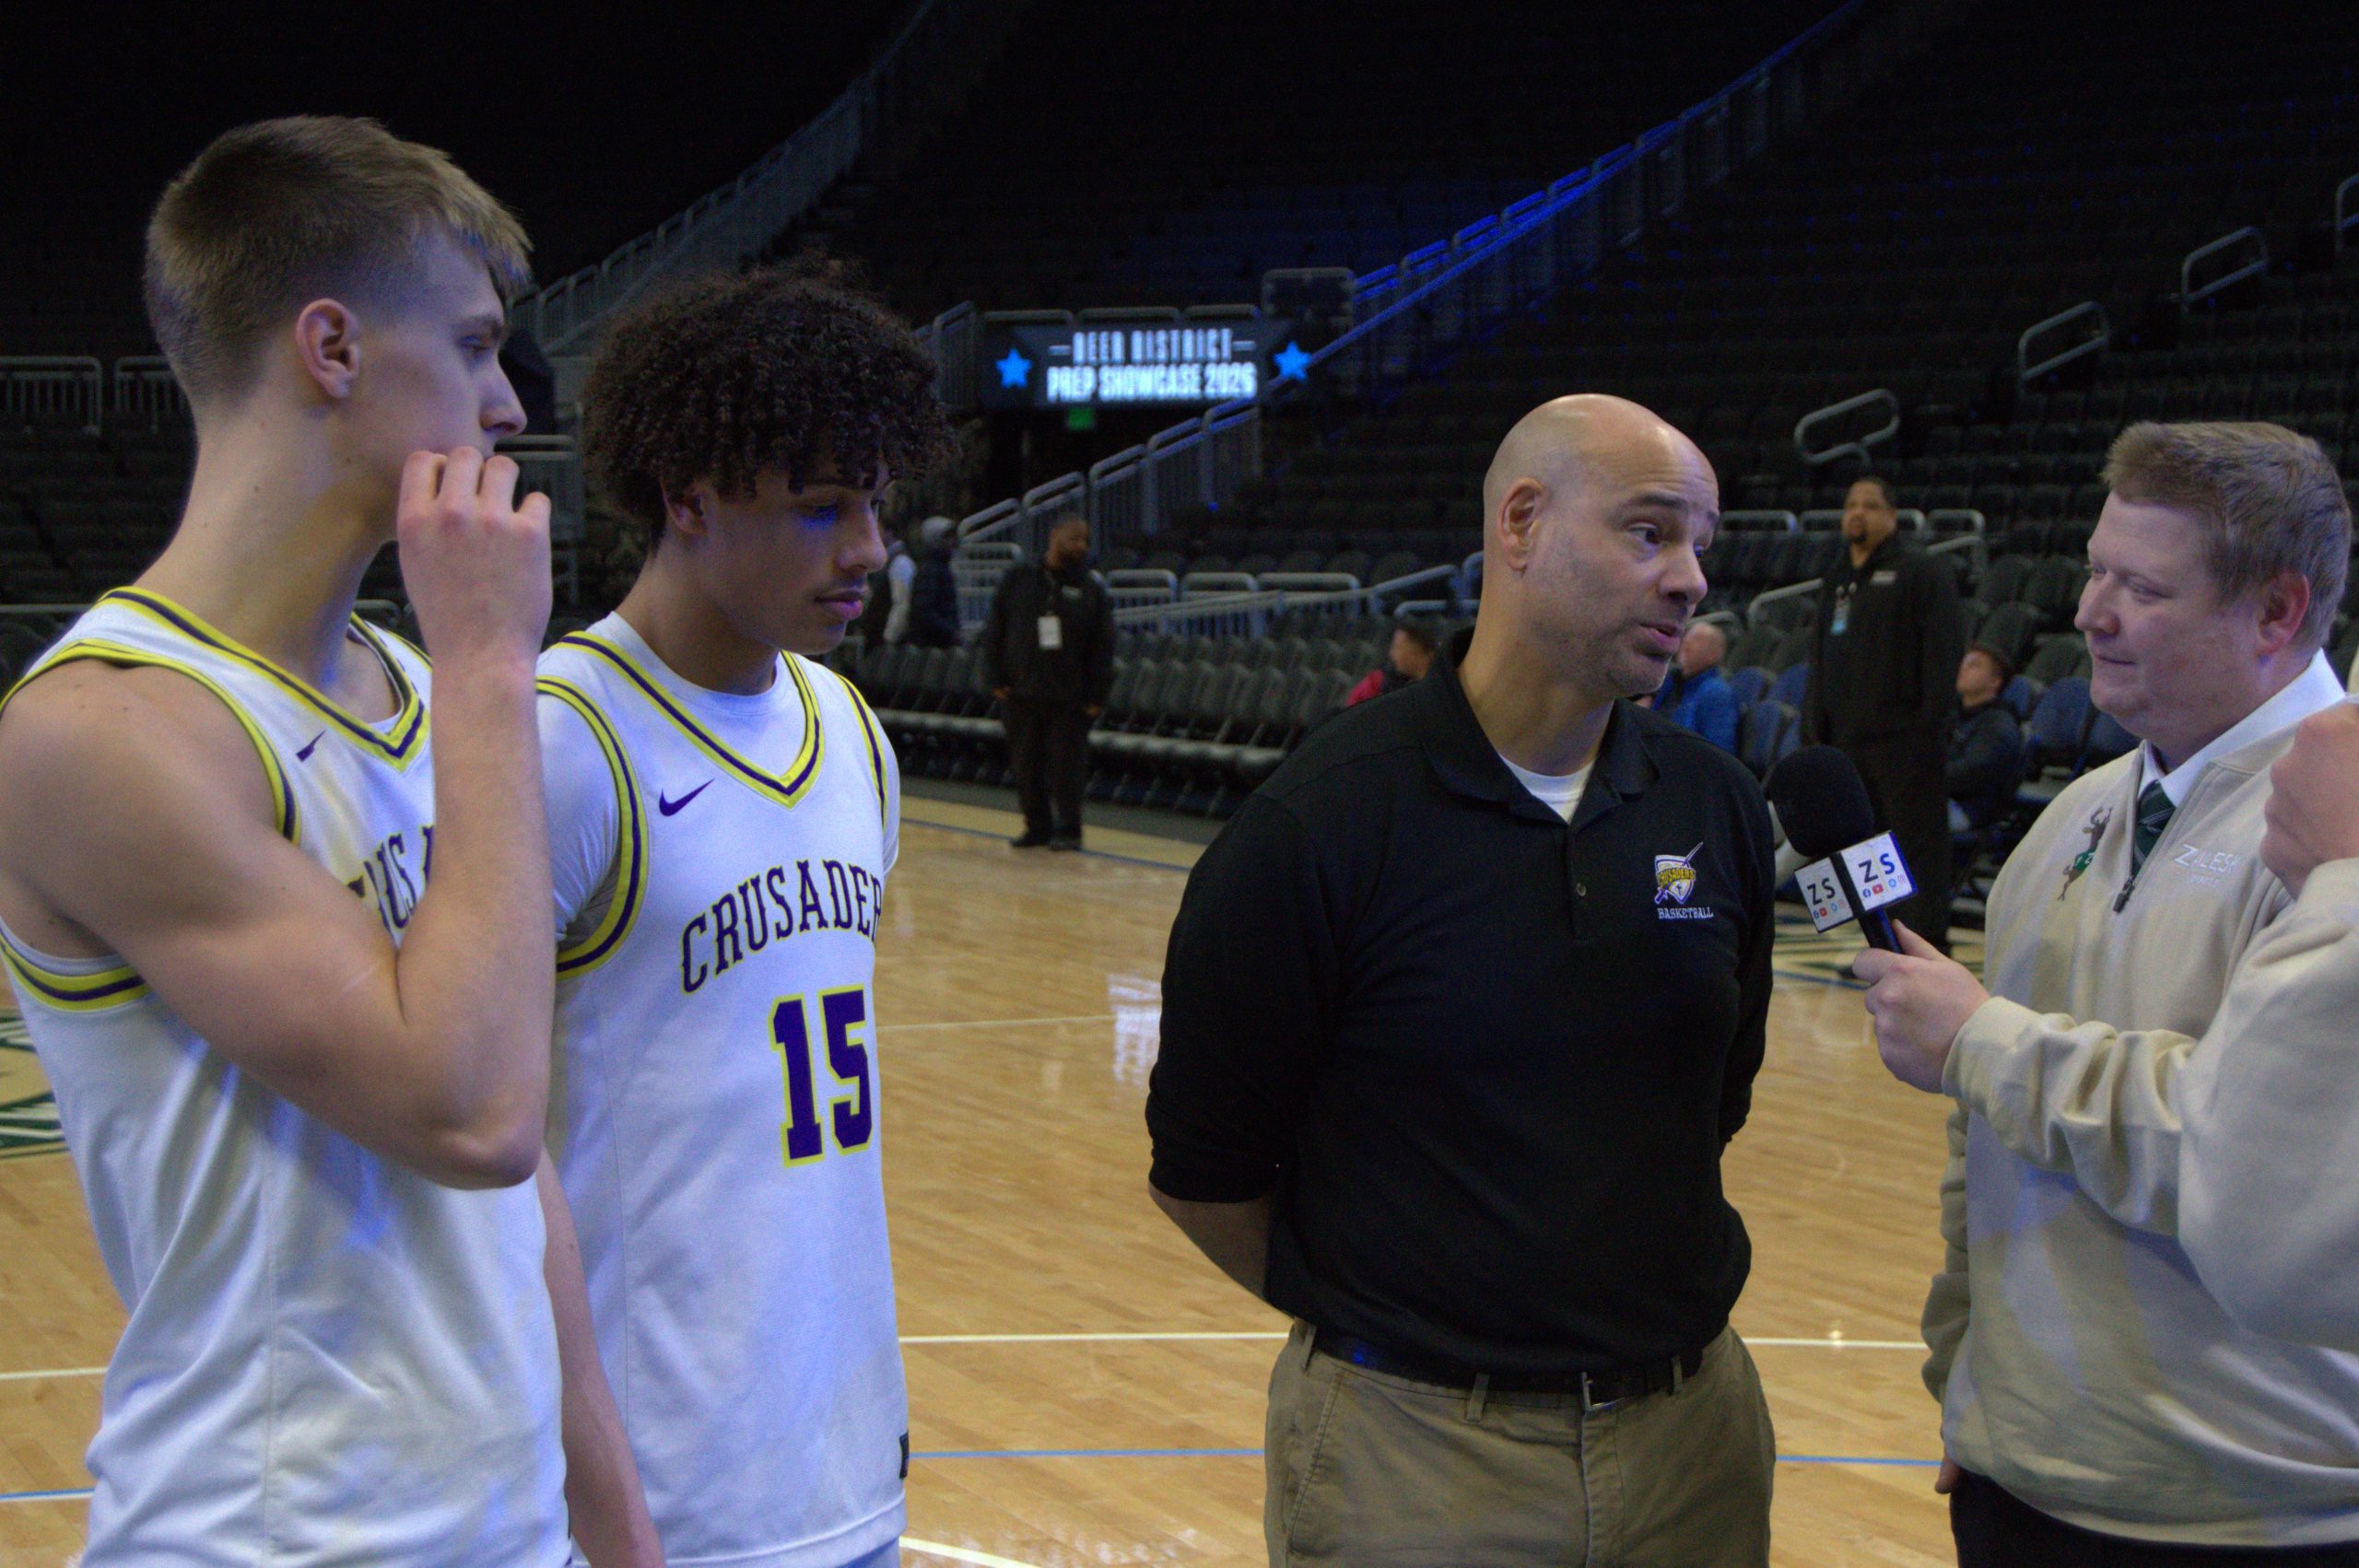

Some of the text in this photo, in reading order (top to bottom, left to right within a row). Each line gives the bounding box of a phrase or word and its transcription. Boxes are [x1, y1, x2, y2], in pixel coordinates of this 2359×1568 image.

[1073, 328, 1233, 365] DEER DISTRICT
[1047, 366, 1097, 402] PREP
[1097, 363, 1203, 401] SHOWCASE
[1657, 907, 1714, 919] BASKETBALL
[767, 984, 874, 1168] 15
